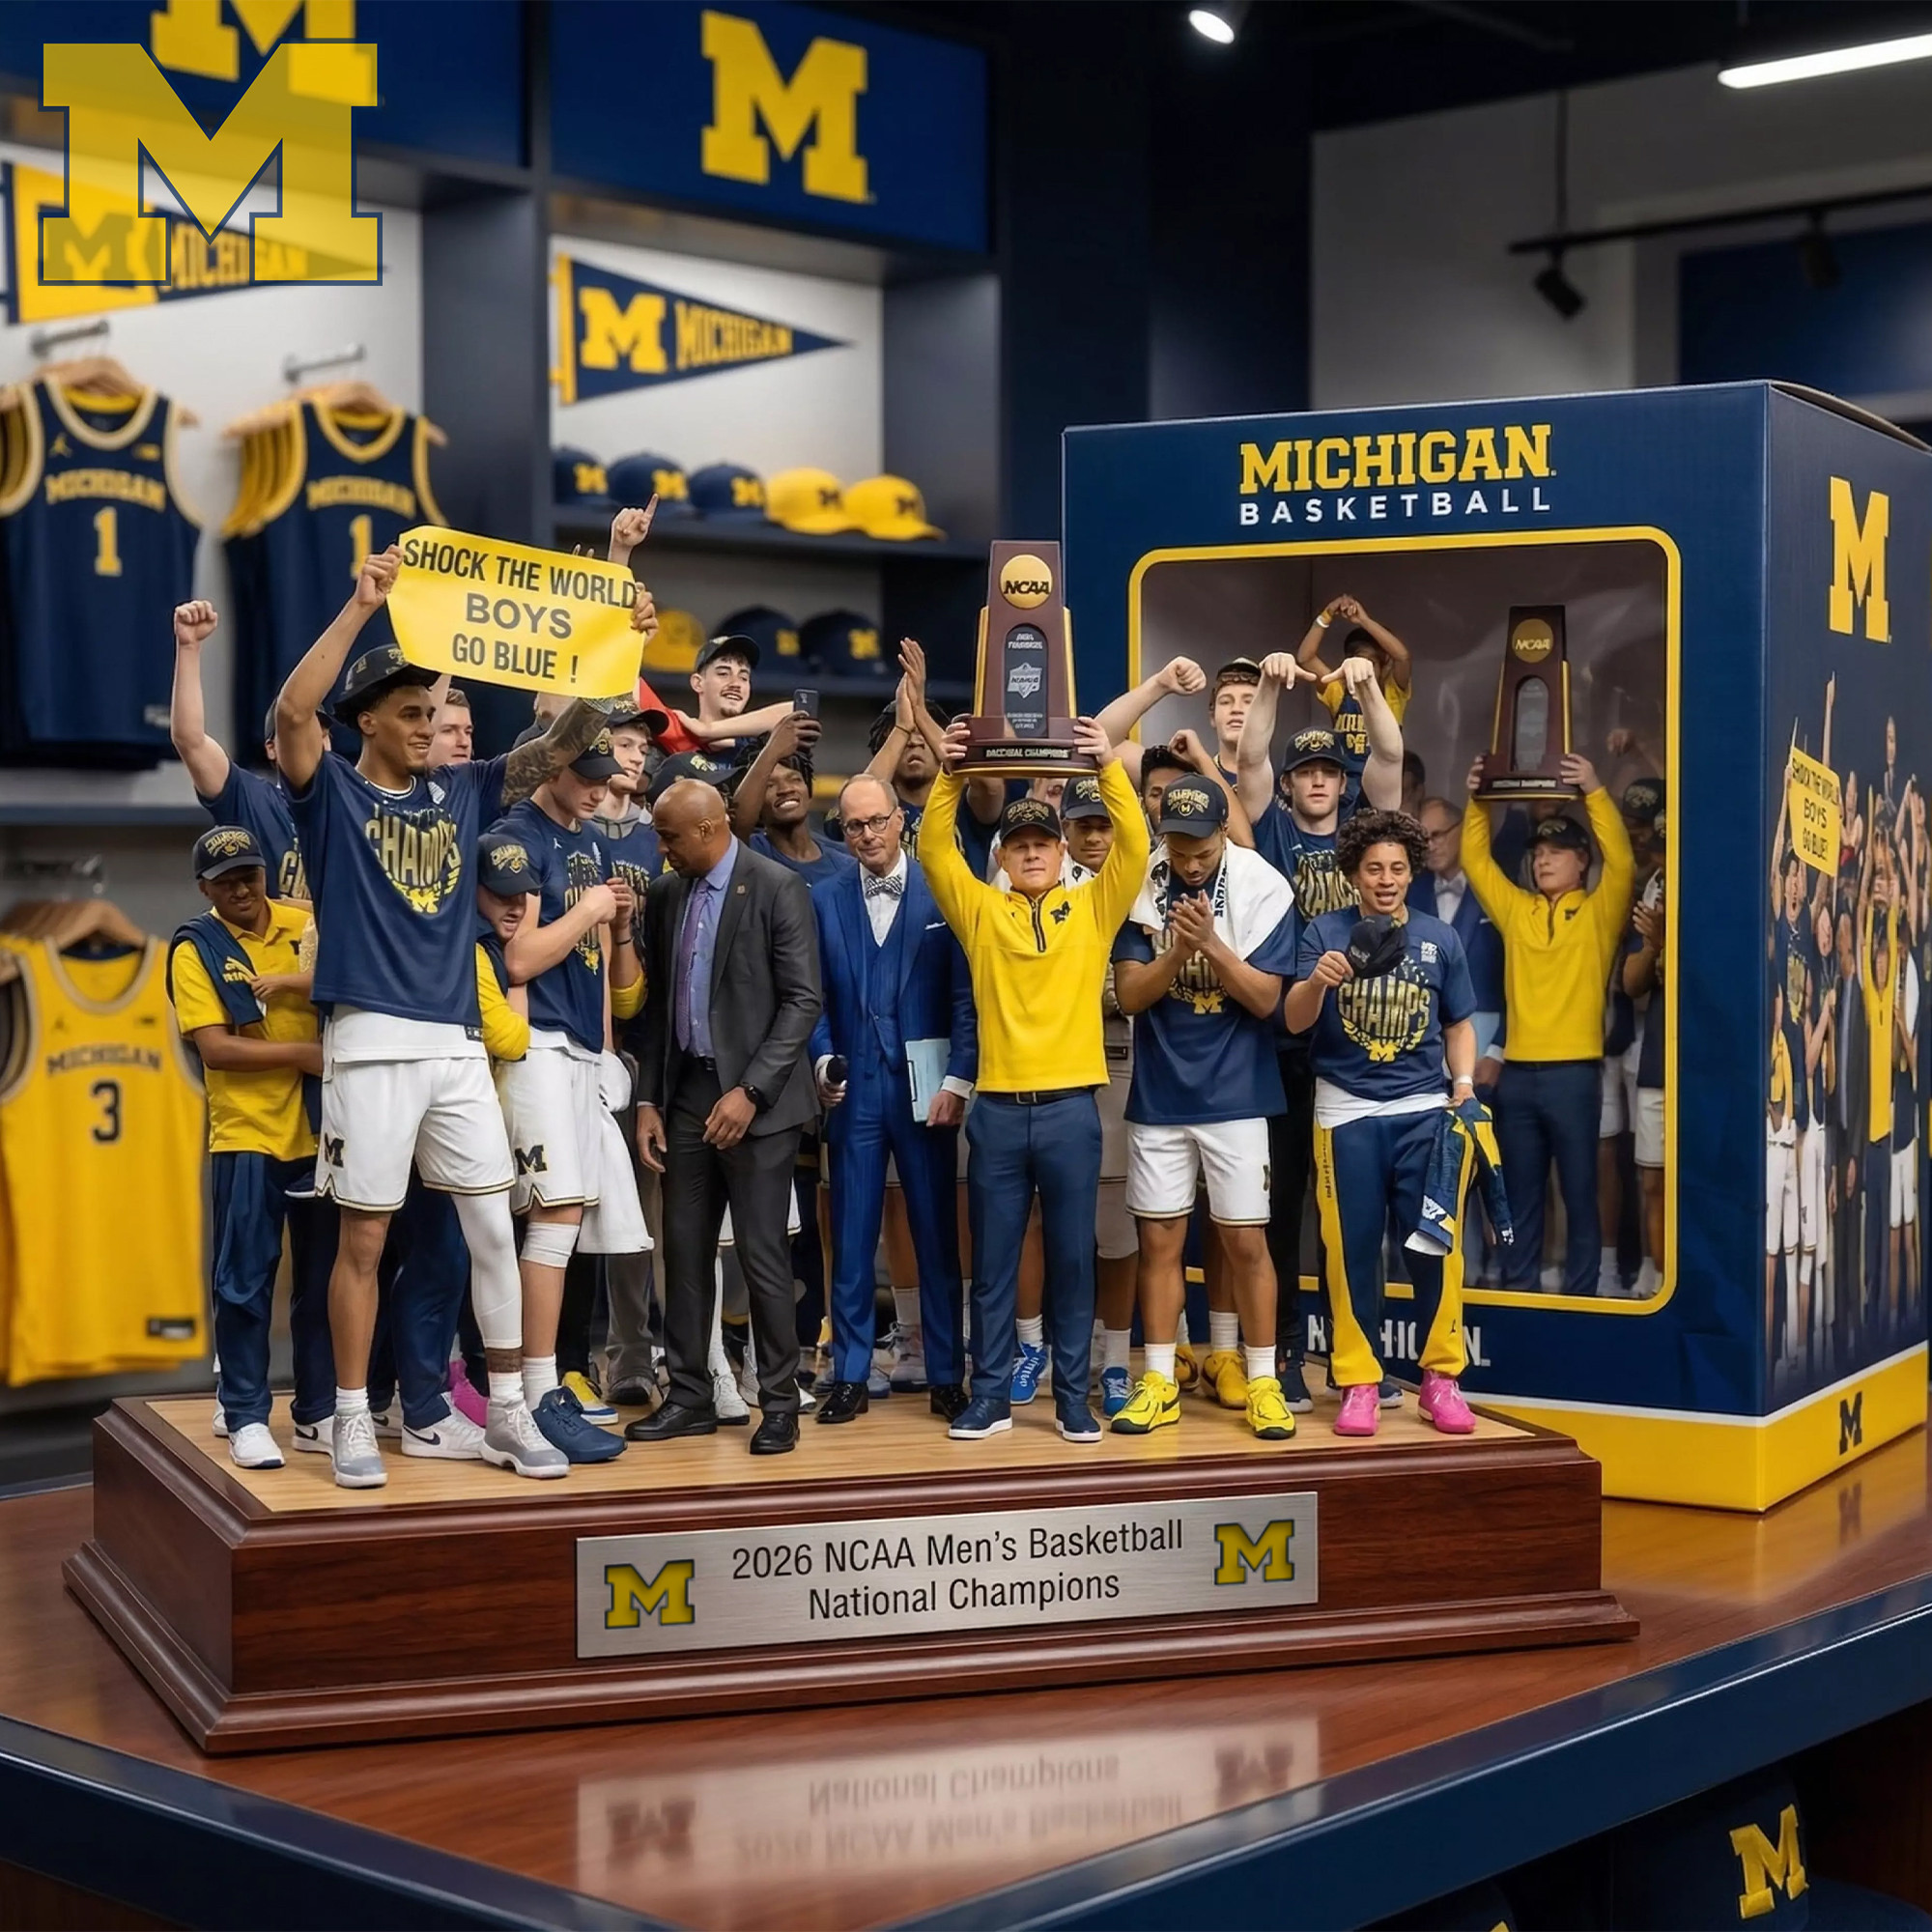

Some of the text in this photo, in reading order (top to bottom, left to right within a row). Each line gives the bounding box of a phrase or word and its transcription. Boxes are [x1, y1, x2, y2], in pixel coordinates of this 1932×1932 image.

[702, 10, 867, 203] M
[579, 286, 793, 374] M MICHIGAN
[45, 468, 166, 513] MICHIGAN
[1239, 424, 1551, 495] MICHIGAN
[1239, 487, 1550, 526] BASKETBALL
[94, 505, 123, 578] 1
[349, 514, 373, 582] 1
[403, 539, 638, 610] SHOCK THE WORLD
[1829, 476, 1889, 643] M
[466, 592, 572, 639] BOYS
[1004, 580, 1050, 595] NCAA
[452, 633, 486, 667] GO
[494, 640, 557, 680] BLUE
[1515, 639, 1550, 651] NCAA
[1338, 975, 1431, 1038] CHAMPS
[92, 1079, 124, 1146] 3
[514, 1145, 548, 1176] M
[1839, 1391, 1863, 1456] M
[732, 1519, 1183, 1579] 2026 NCAA Men's Basketball
[1213, 1519, 1295, 1586] M
[605, 1559, 695, 1630] M
[810, 1572, 1121, 1620] National Champions
[1729, 1803, 1810, 1919] M
